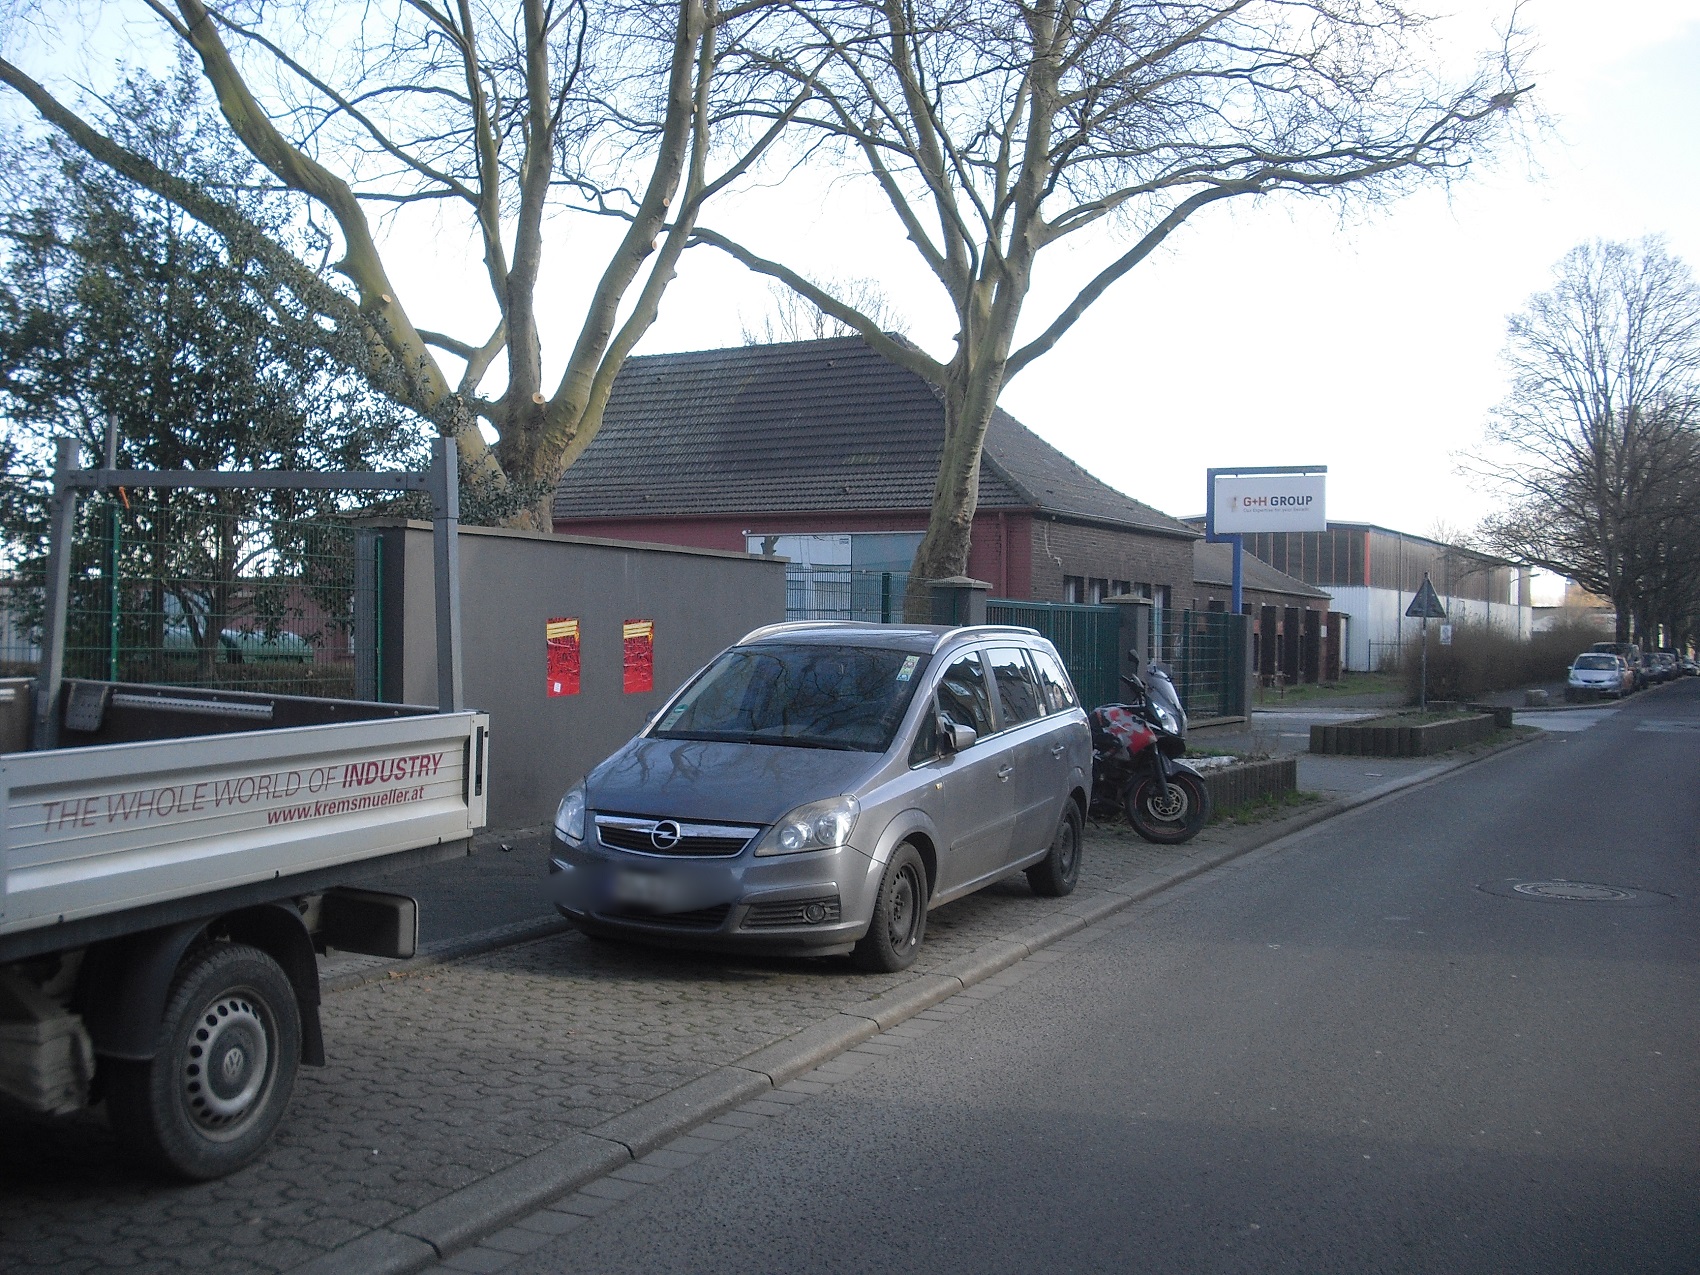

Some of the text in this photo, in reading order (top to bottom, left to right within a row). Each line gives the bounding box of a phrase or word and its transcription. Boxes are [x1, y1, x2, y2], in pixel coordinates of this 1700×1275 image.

[1243, 495, 1313, 507] G+H GROUP
[42, 753, 444, 833] THE WHOLE WORLD OF INDUSTRY
[267, 785, 425, 825] www.kremsmueller.at
